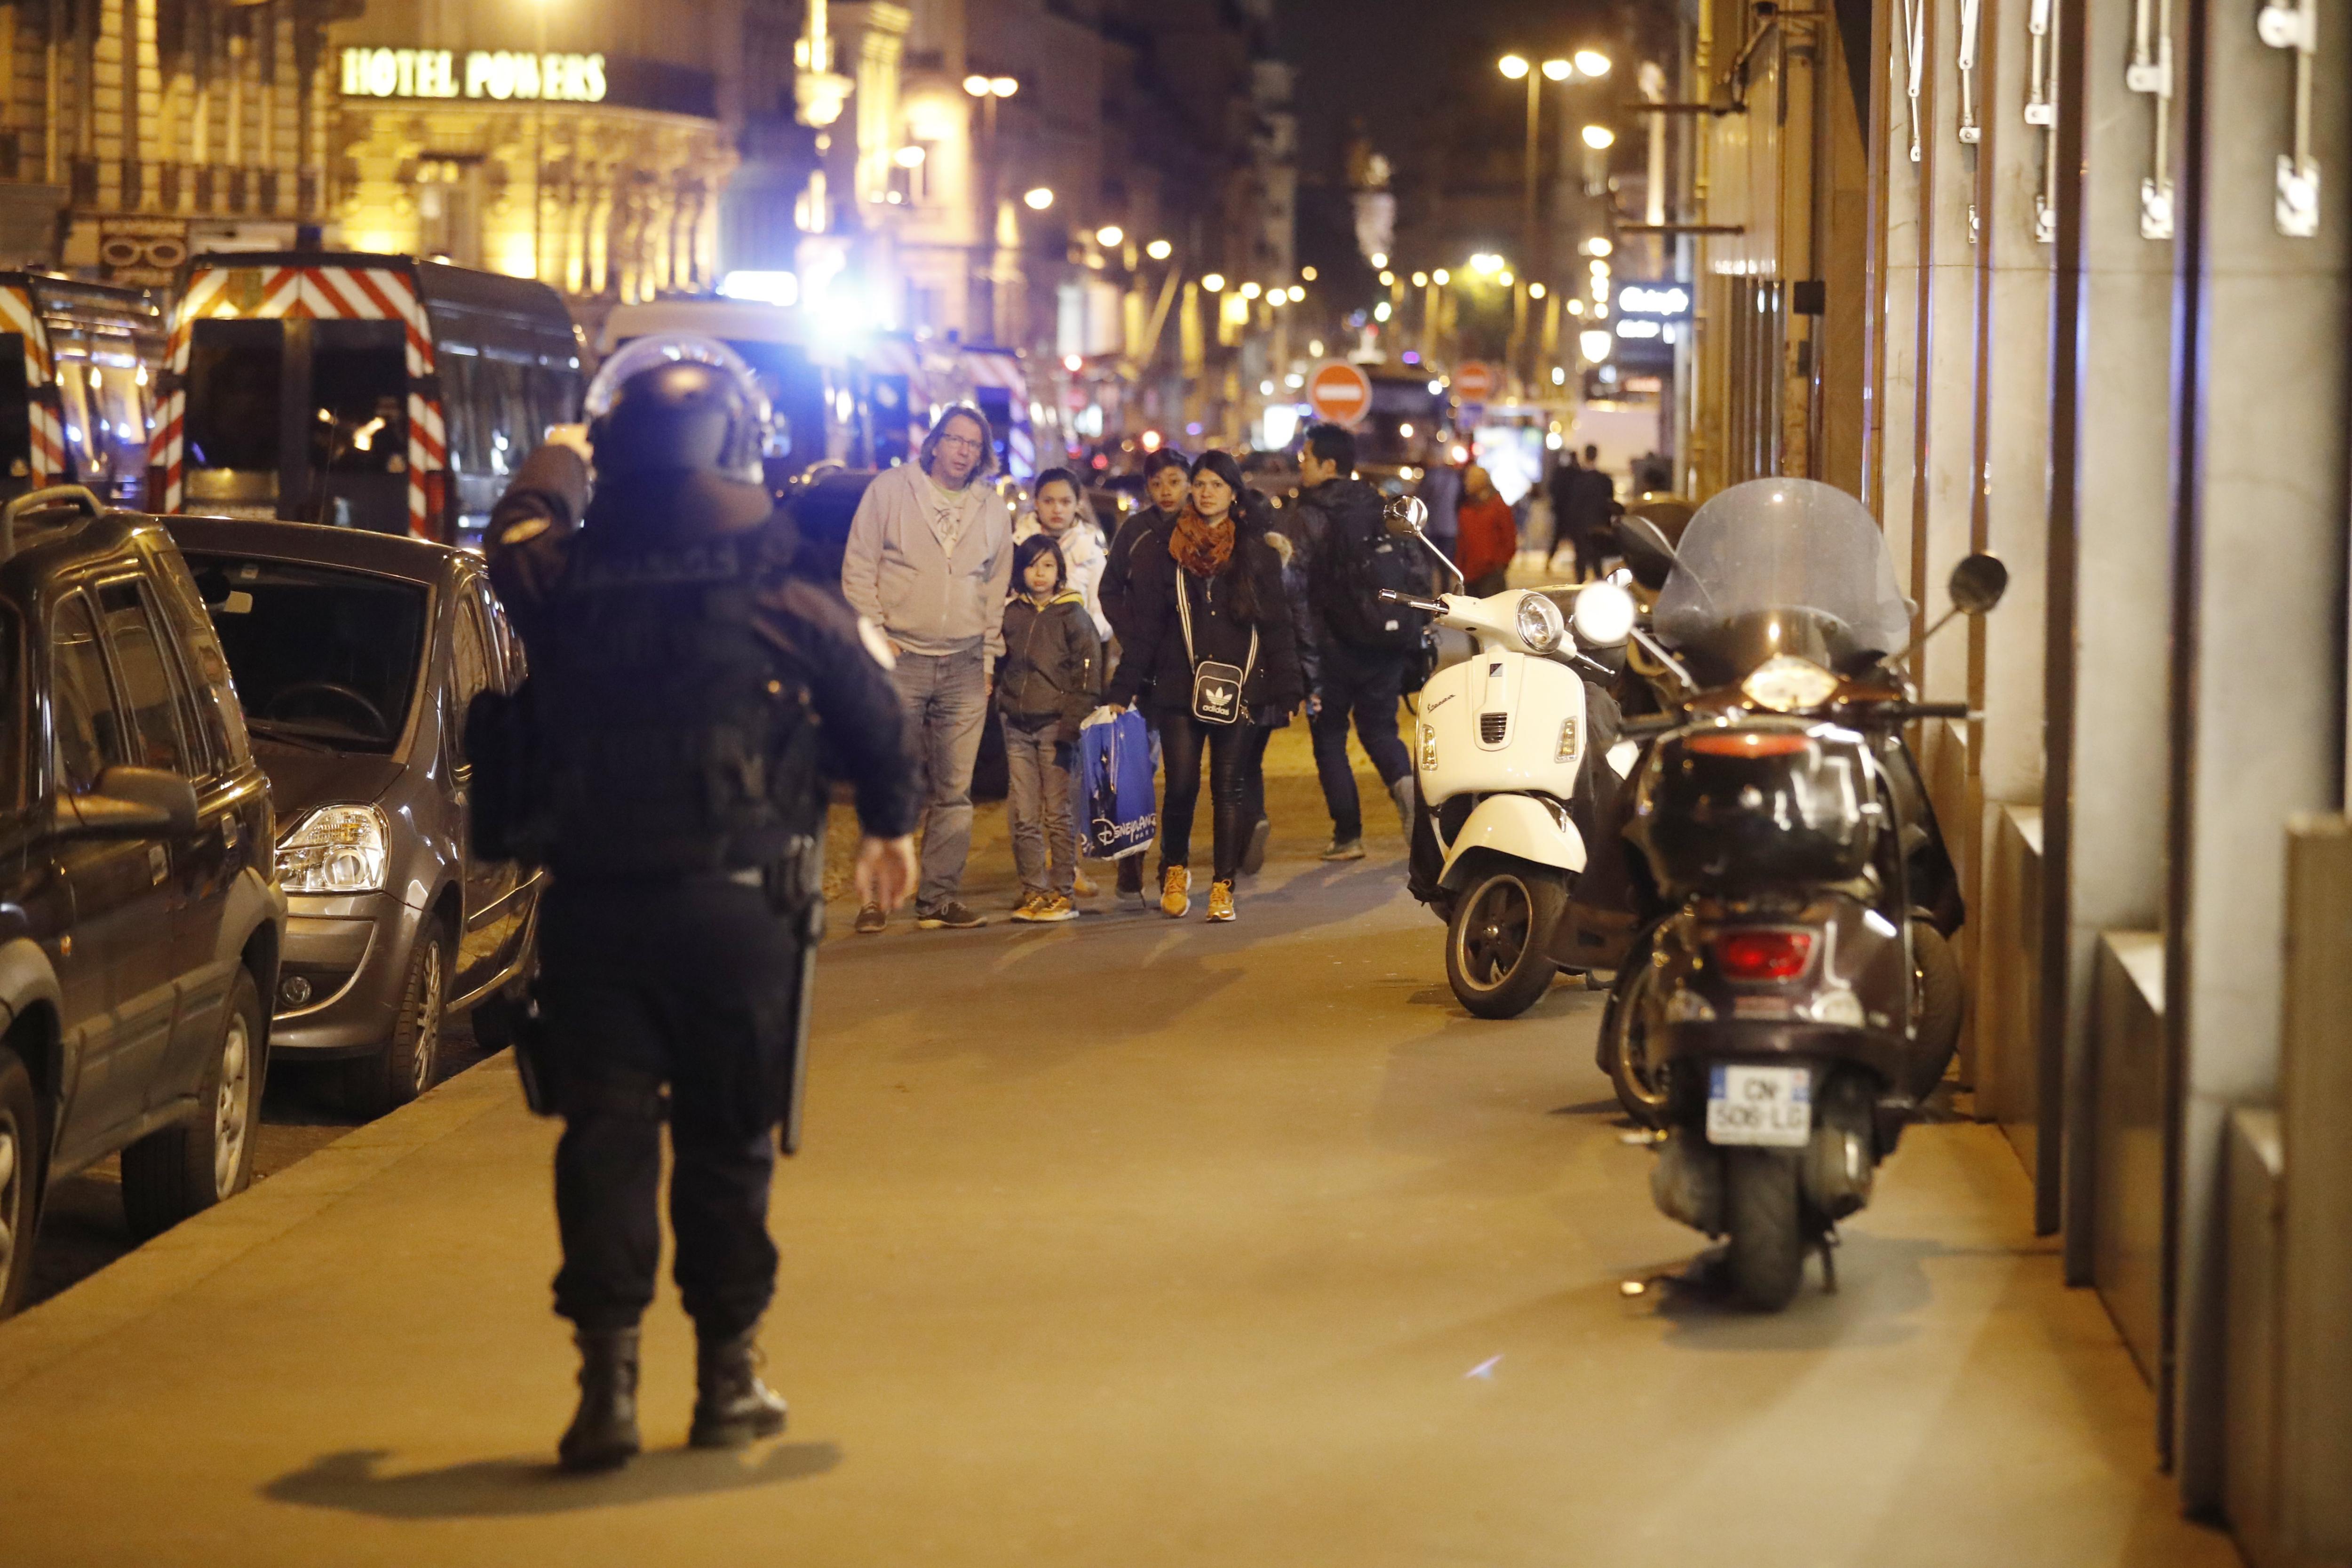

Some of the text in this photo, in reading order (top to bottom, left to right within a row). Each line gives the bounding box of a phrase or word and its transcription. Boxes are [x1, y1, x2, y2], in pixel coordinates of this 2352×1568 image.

[341, 46, 607, 102] HOTEL POWERS
[1202, 705, 1229, 716] adidas
[1428, 694, 1455, 713] Vespa
